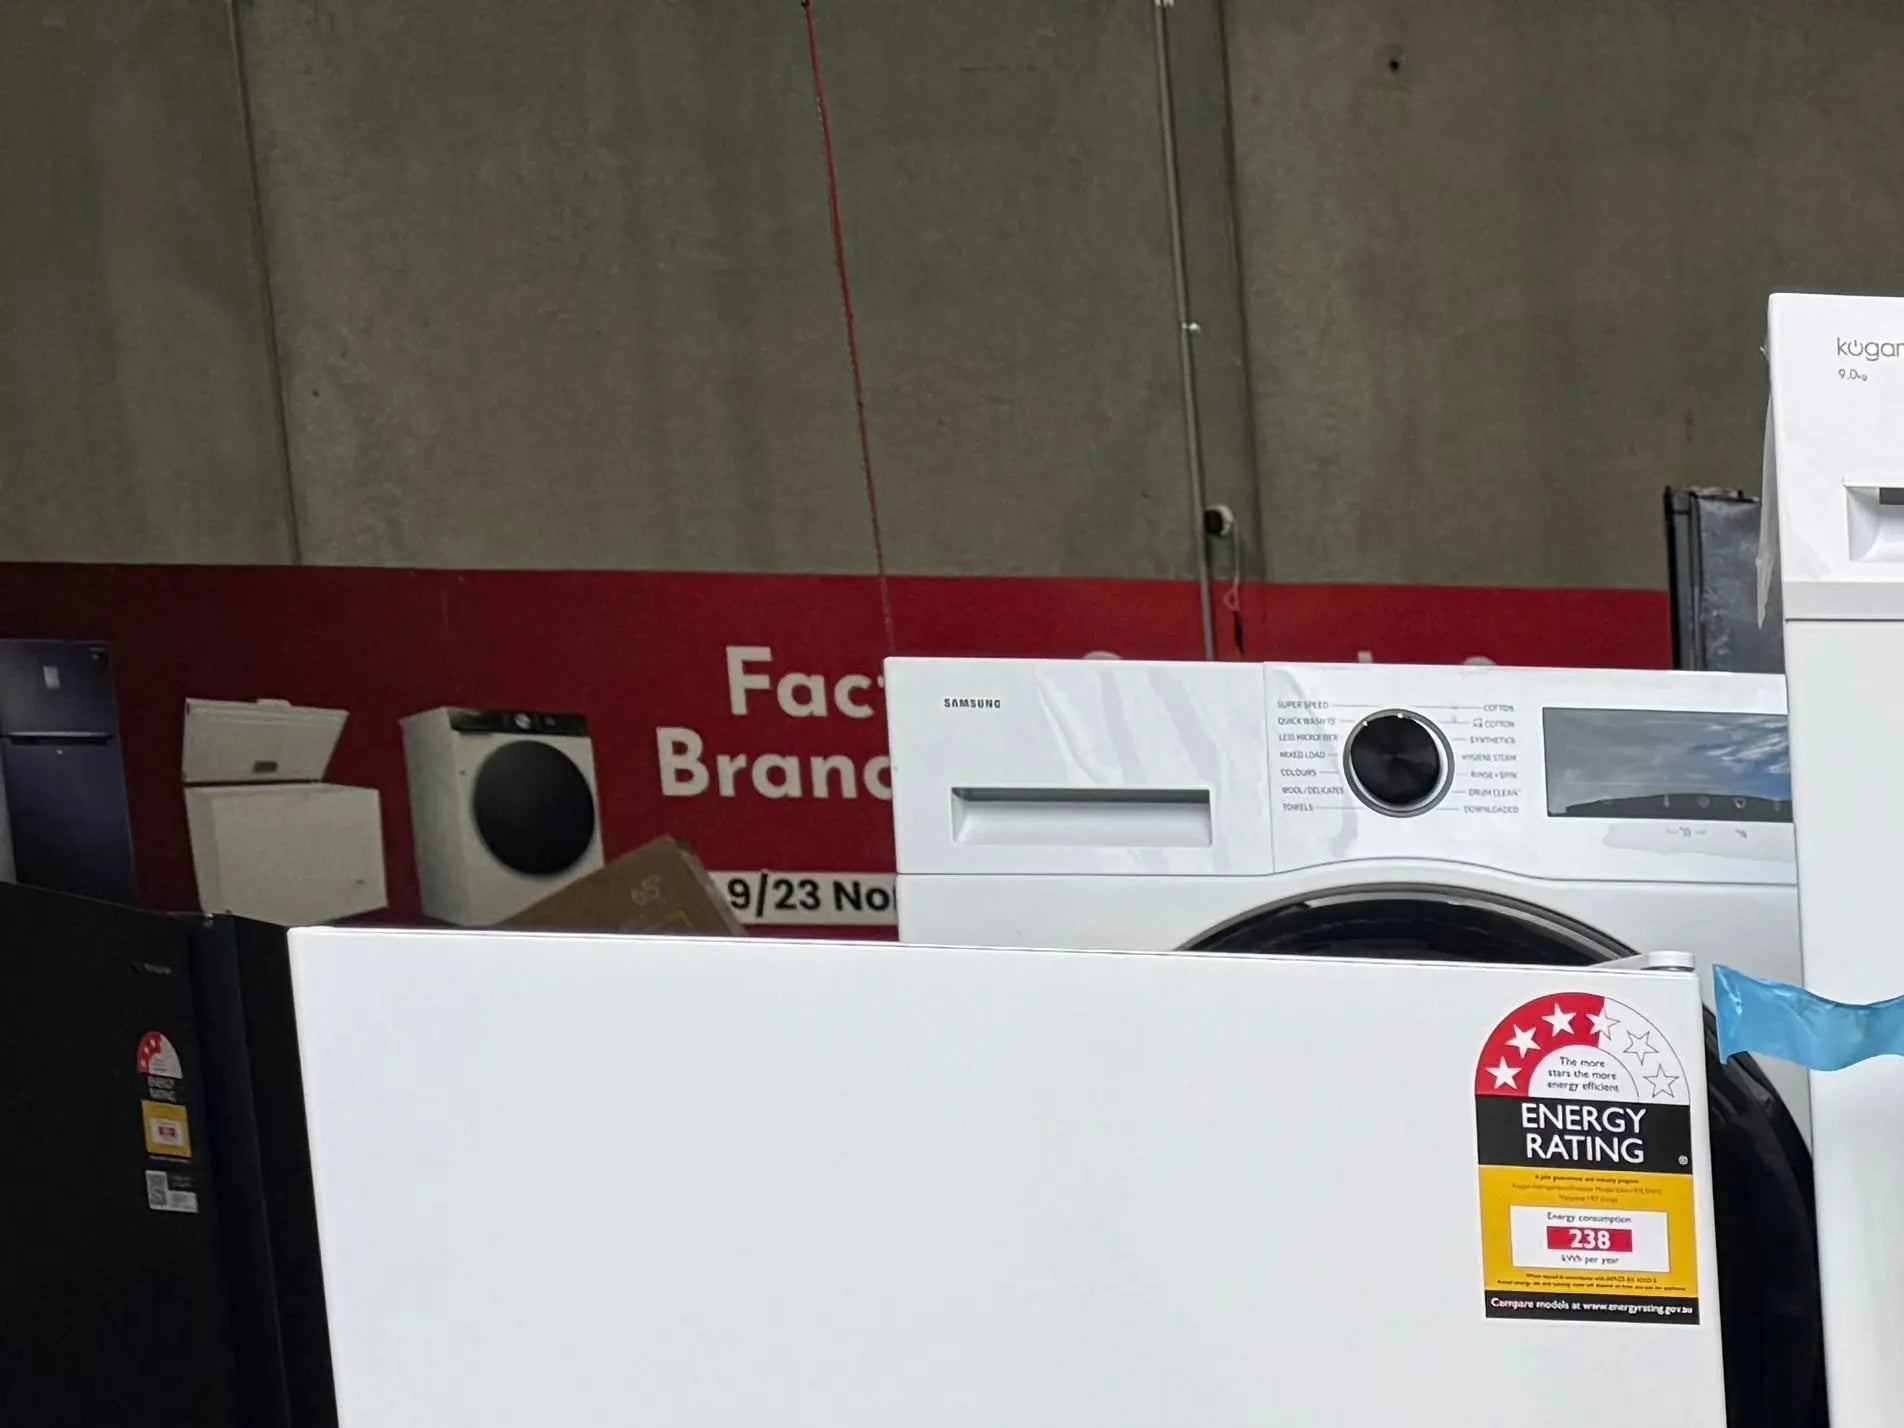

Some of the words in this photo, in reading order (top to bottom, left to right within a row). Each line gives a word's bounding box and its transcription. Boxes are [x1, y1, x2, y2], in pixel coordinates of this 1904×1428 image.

[726, 645, 884, 718] Fac
[944, 697, 1001, 709] SAMSUNG
[727, 873, 820, 917] 9/23
[833, 879, 897, 911] No
[1560, 1056, 1578, 1067] The
[1580, 1059, 1605, 1067] more
[1549, 1069, 1571, 1078] stars
[1573, 1070, 1589, 1079] the
[1592, 1071, 1616, 1080] more
[1547, 1080, 1580, 1092] energy
[1582, 1081, 1619, 1092] efficient
[1521, 1102, 1647, 1133] ENERGY
[1526, 1134, 1644, 1163] RATING
[1547, 1212, 1575, 1224] Energy
[1578, 1214, 1632, 1225] consumption
[1569, 1229, 1610, 1248] 238
[1491, 1297, 1534, 1310] Compare
[1536, 1299, 1569, 1311] models
[1572, 1301, 1581, 1310] at
[1583, 1301, 1693, 1315] www.energyrating.gov.au
